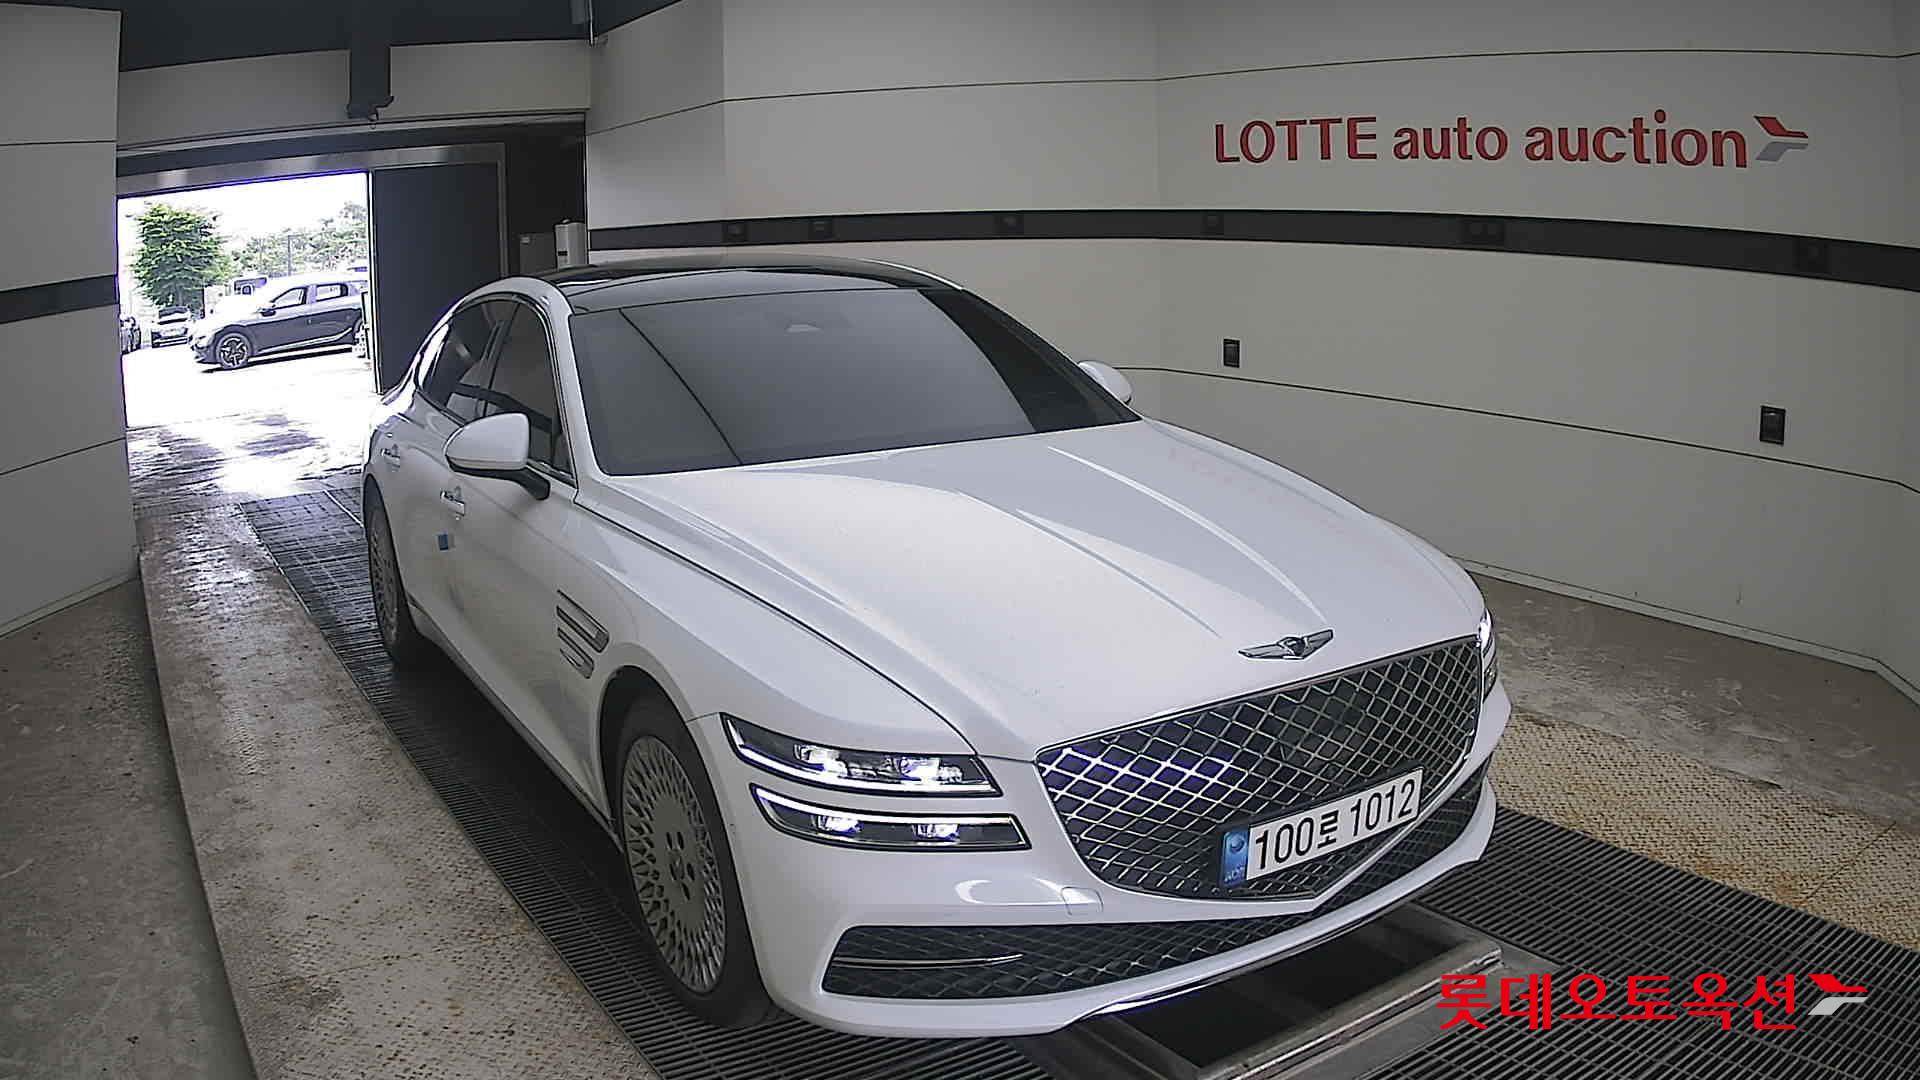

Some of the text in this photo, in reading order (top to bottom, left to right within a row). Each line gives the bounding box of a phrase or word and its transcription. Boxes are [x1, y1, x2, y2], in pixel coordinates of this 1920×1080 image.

[1215, 109, 1749, 169] LOTTE auto auction
[1255, 779, 1416, 870] 100로 1012
